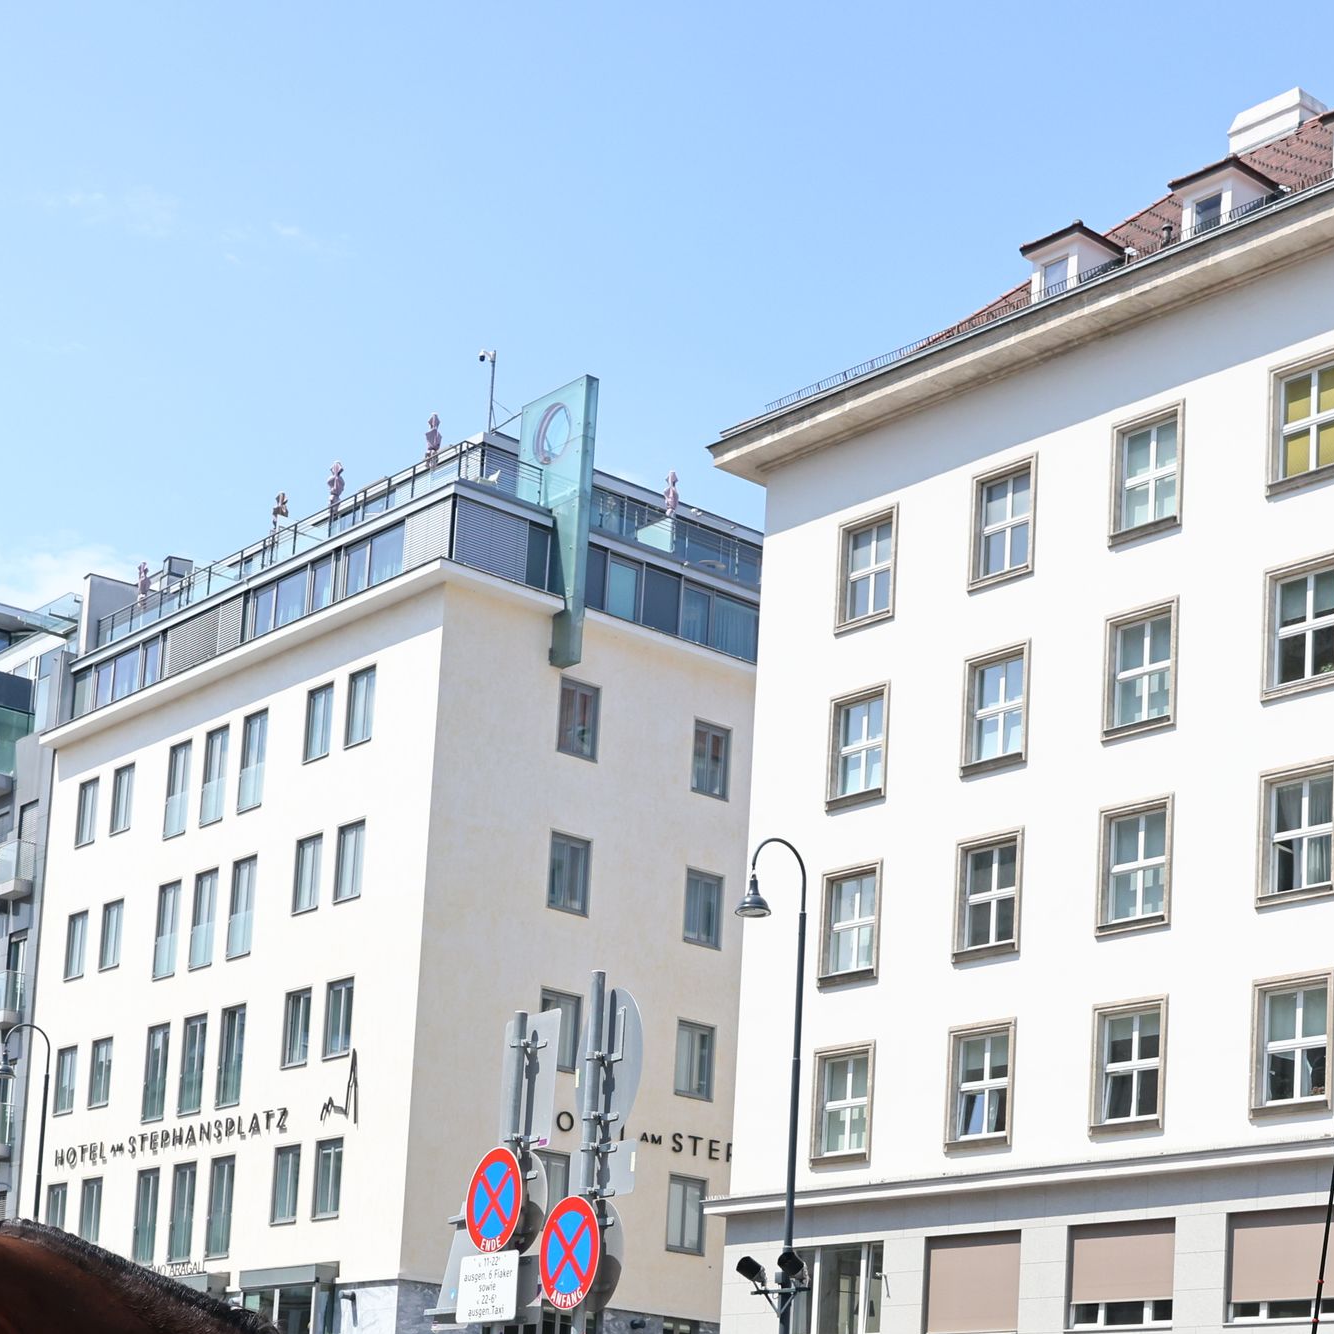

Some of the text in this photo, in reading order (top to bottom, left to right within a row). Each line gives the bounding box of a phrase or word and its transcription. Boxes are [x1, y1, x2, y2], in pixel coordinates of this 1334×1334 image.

[54, 1142, 107, 1169] HOTEL
[128, 1107, 289, 1155] STEPHANSPLATZ
[640, 1132, 662, 1145] AM
[480, 1237, 501, 1252] ENDE
[489, 1270, 493, 1279] 6
[494, 1269, 513, 1279] Fiaker
[478, 1282, 496, 1292] sowie
[550, 1287, 583, 1307] ANFANG
